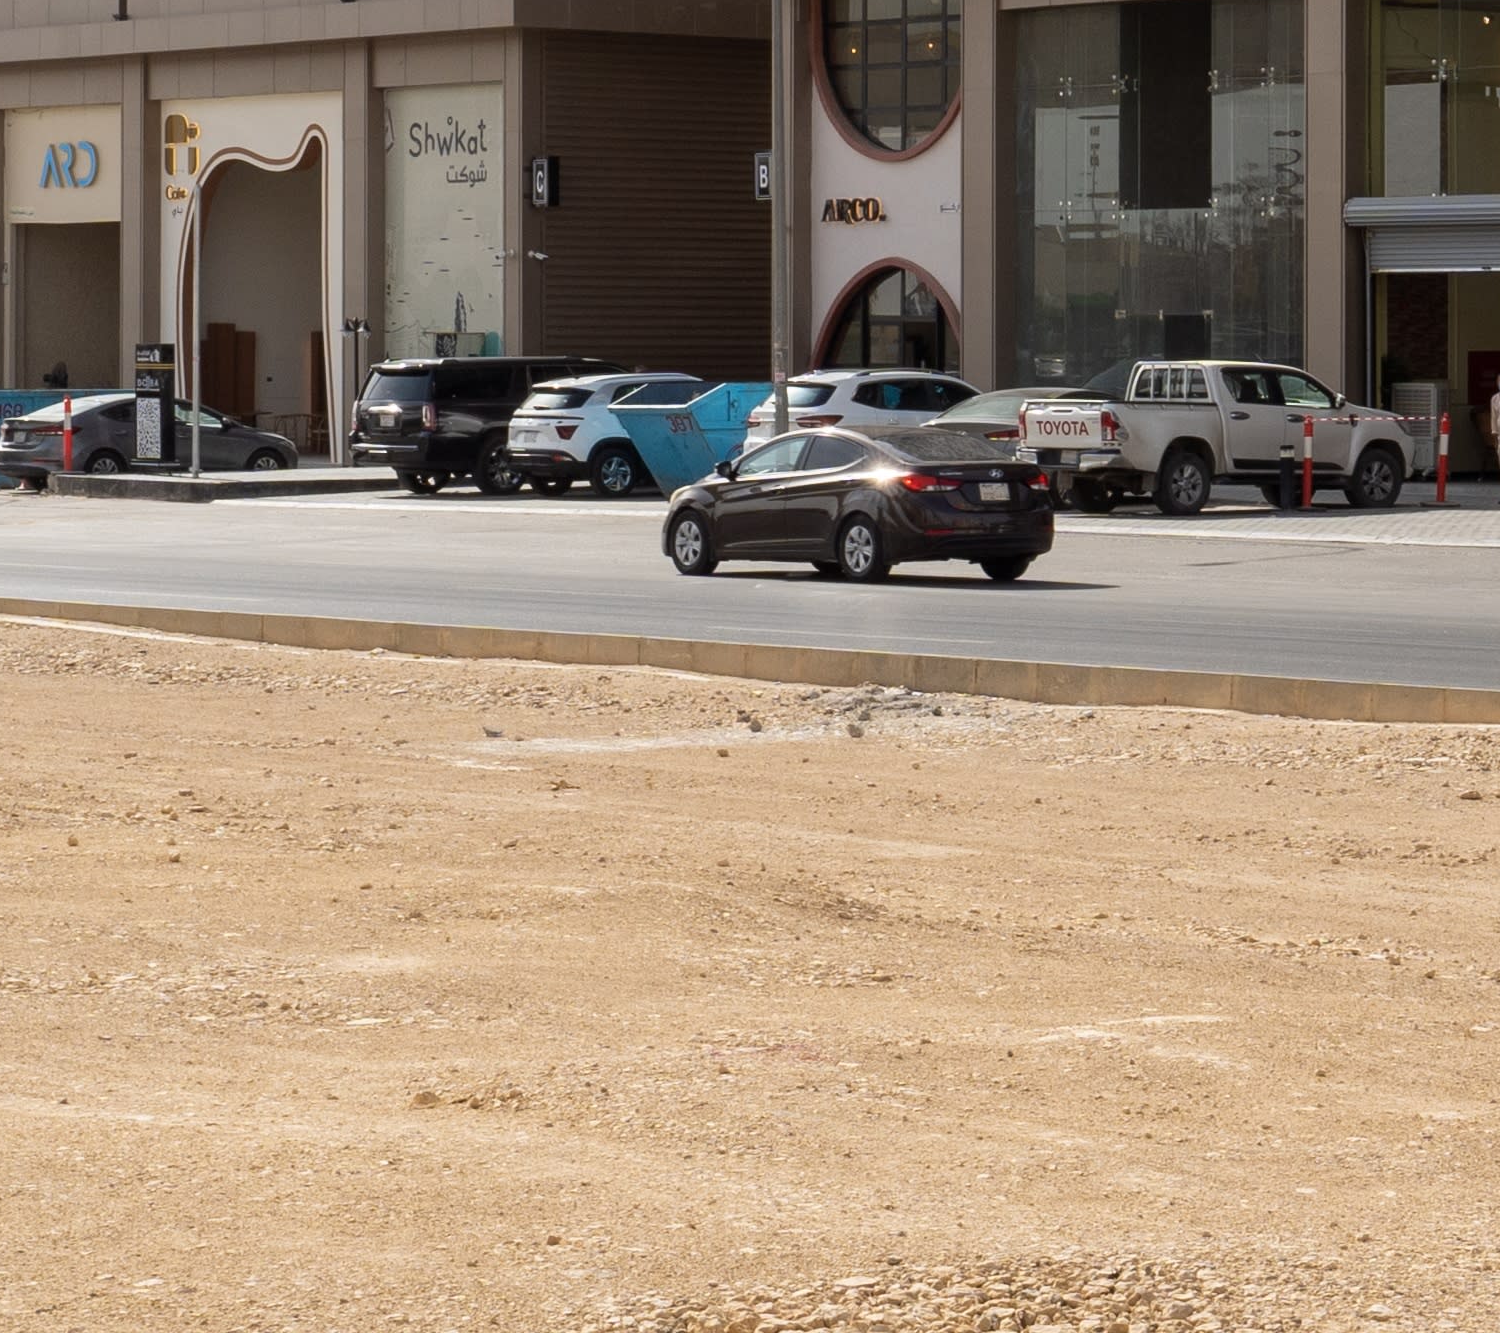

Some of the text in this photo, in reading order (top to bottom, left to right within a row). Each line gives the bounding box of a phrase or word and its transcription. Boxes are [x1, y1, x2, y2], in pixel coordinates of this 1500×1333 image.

[408, 116, 488, 158] Shwkat
[446, 160, 488, 188] شوكت
[535, 170, 544, 193] C
[758, 164, 769, 189] B
[1036, 420, 1089, 436] TOYOTA
